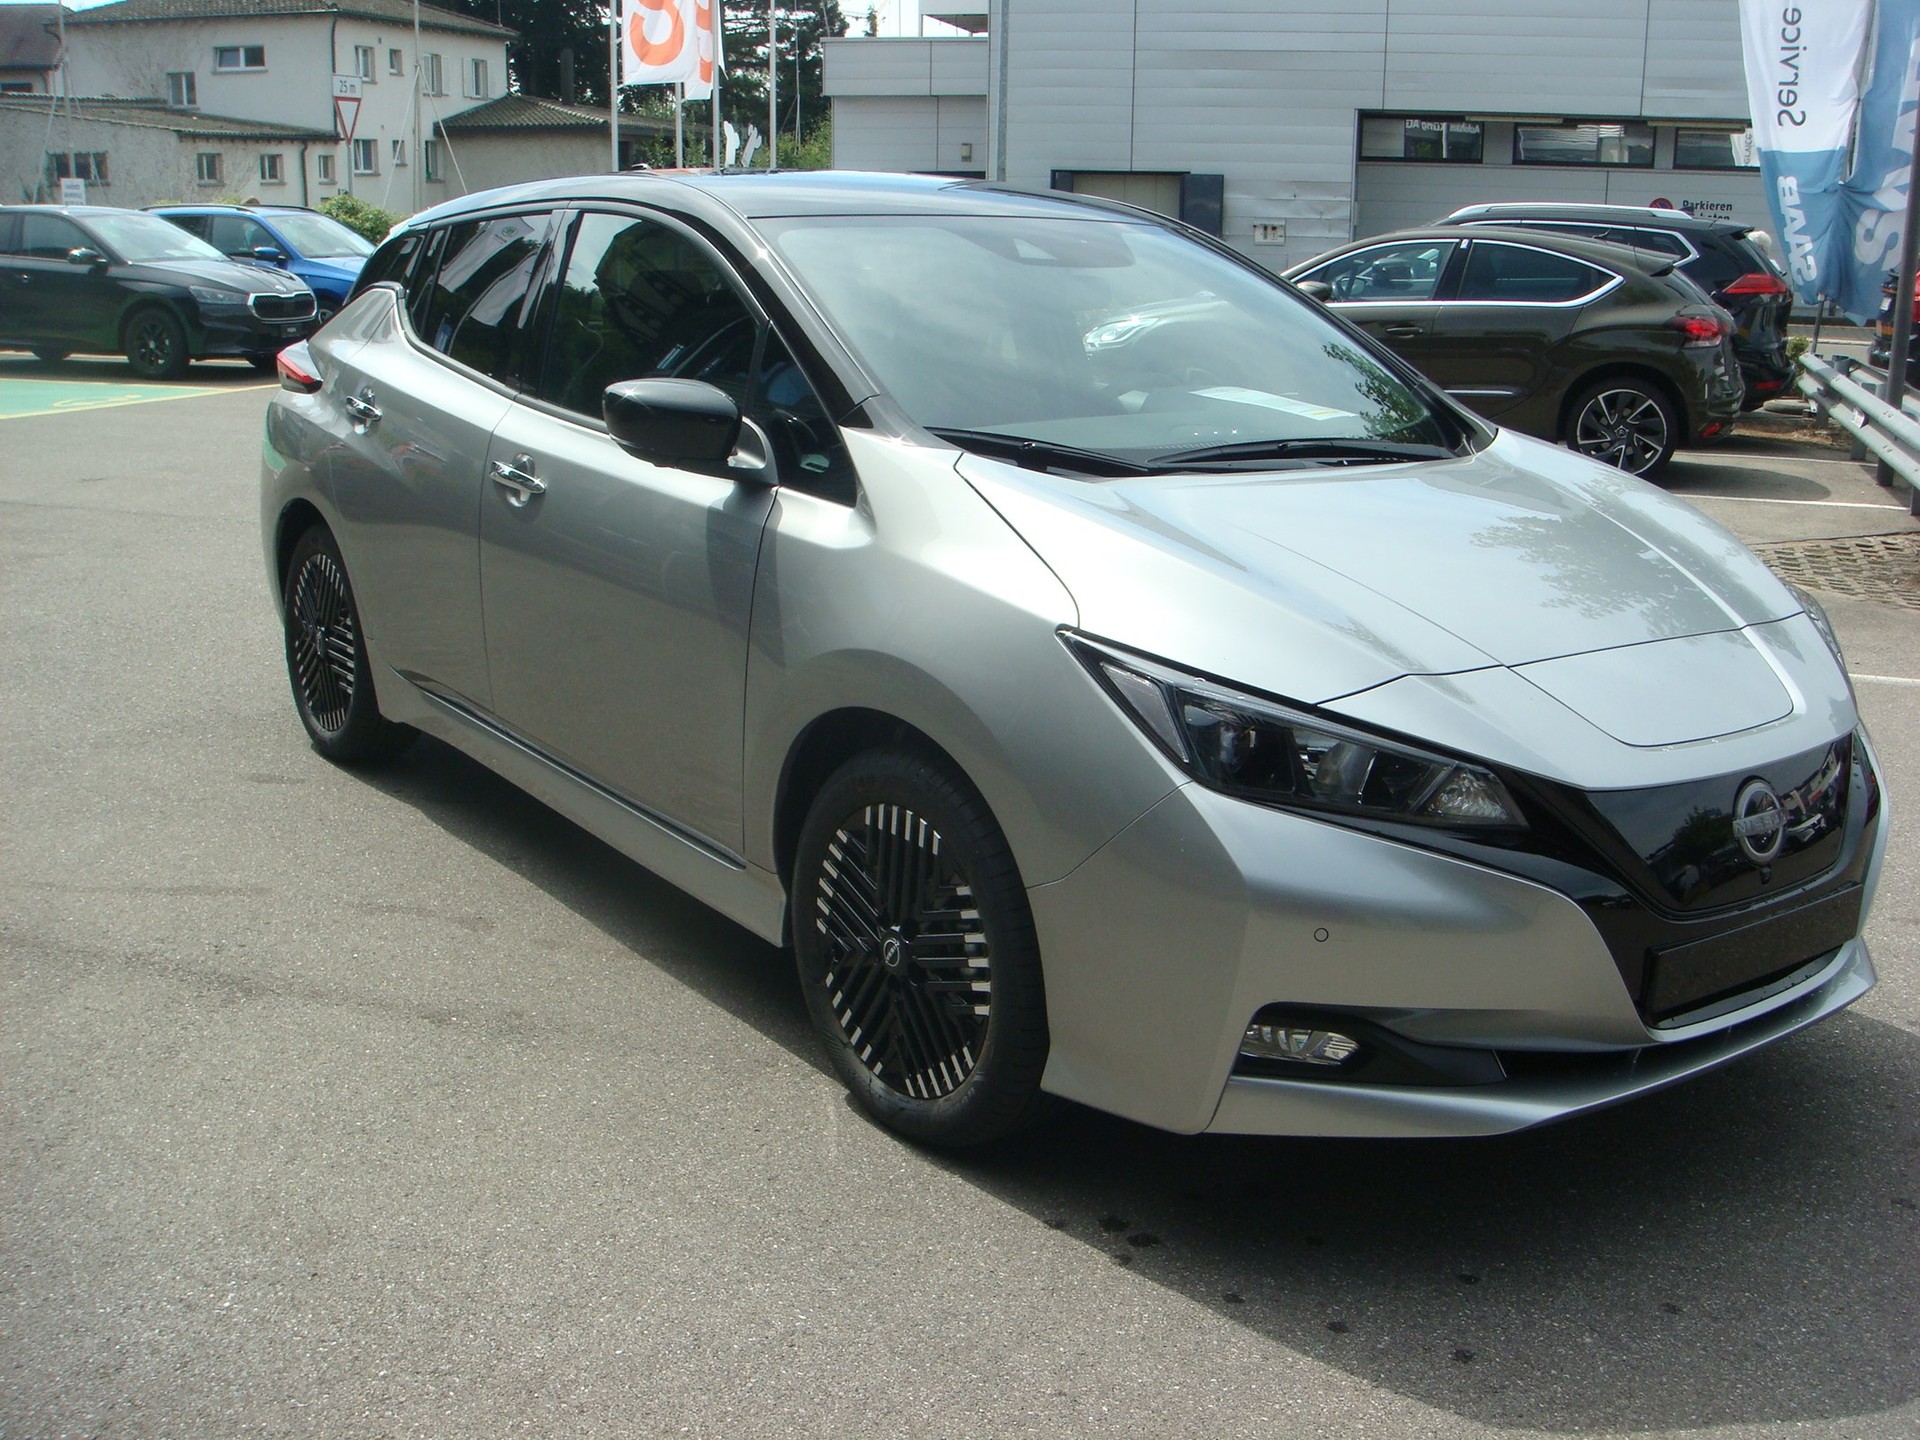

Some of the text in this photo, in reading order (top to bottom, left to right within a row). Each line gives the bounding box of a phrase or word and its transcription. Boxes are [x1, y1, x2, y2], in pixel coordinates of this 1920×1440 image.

[339, 80, 357, 94] 25 m
[1682, 199, 1733, 211] Parkieren
